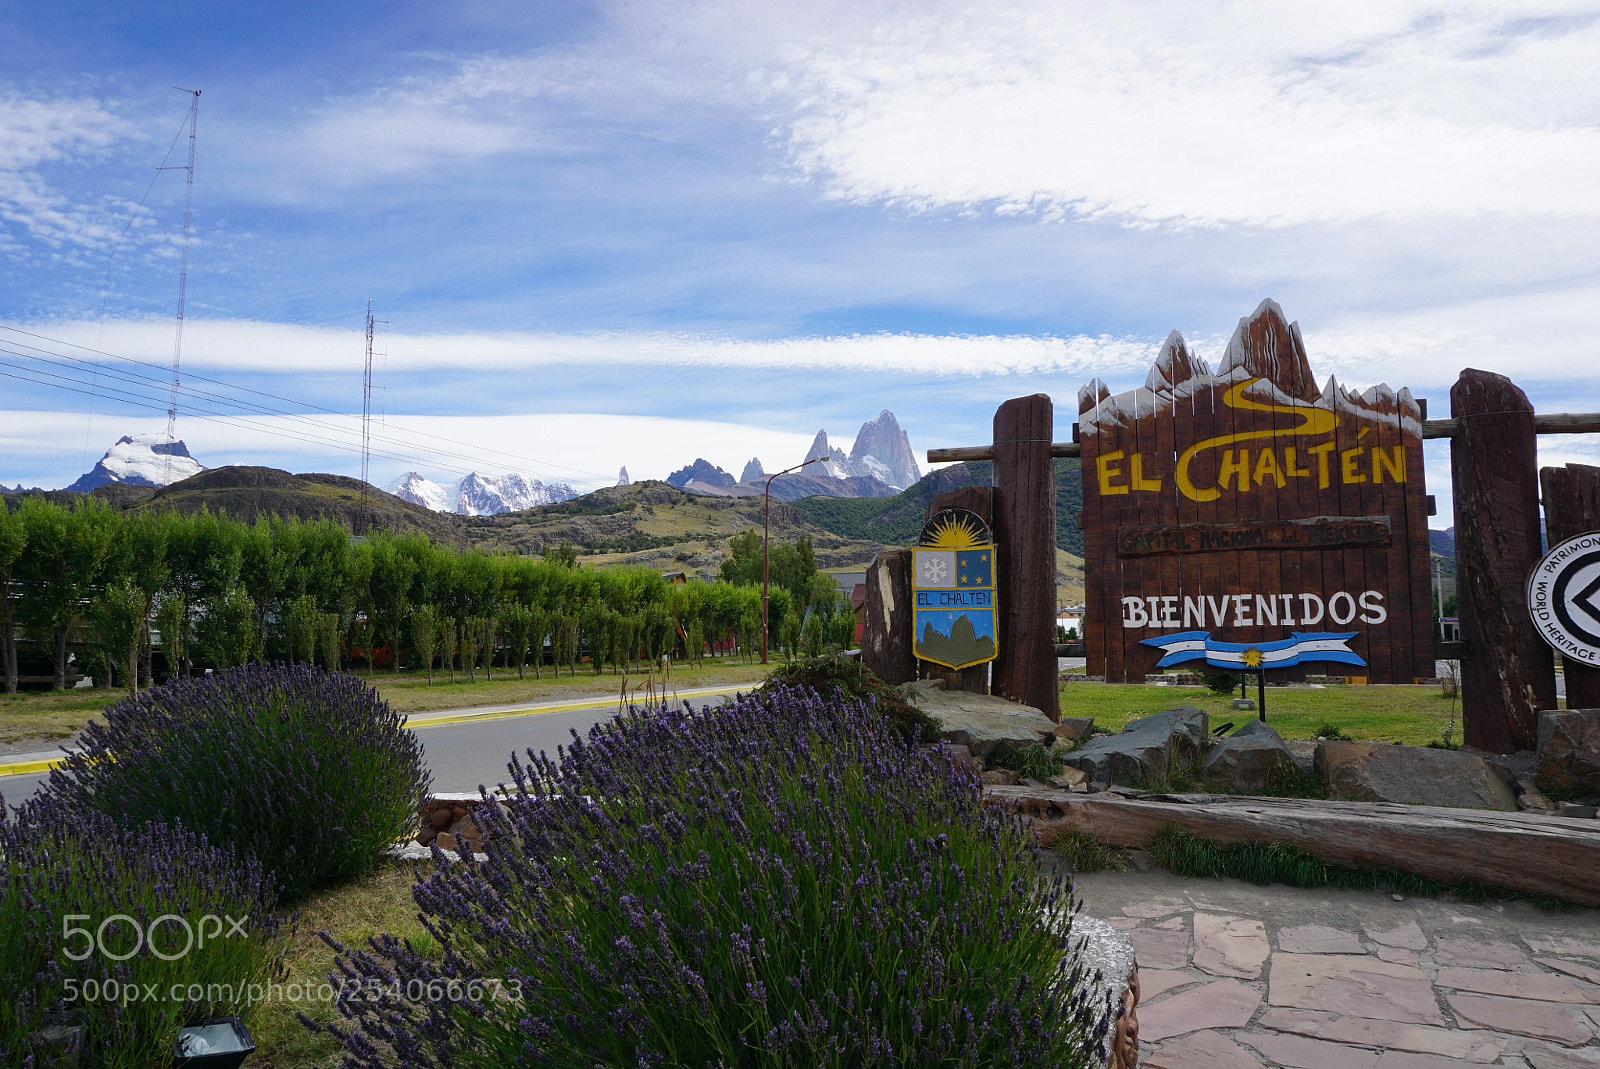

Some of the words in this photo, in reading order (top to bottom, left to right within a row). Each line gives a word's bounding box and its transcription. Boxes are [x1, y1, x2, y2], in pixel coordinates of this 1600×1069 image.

[1096, 450, 1162, 496] EL
[1176, 427, 1408, 501] CHALTÉN
[917, 592, 932, 606] EL
[939, 592, 991, 605] CHALTEN
[1122, 591, 1388, 628] BIENVENIDOS
[1536, 581, 1550, 621] WORLD
[1544, 624, 1596, 661] HERITAGE
